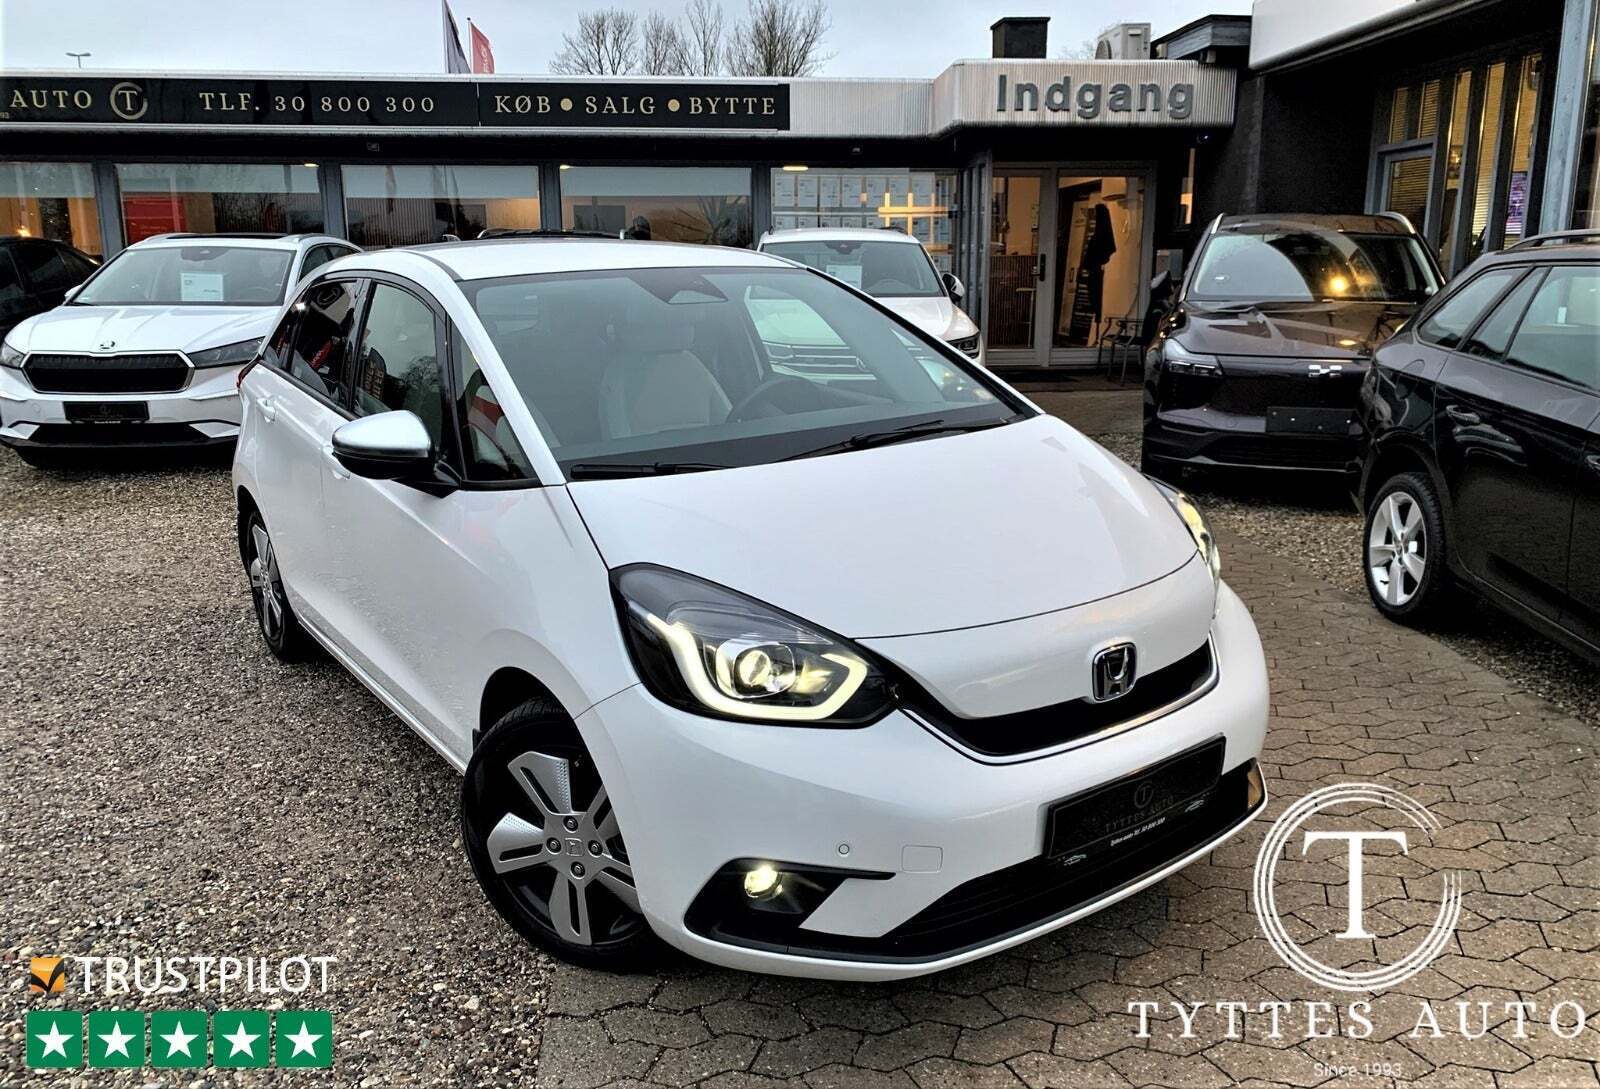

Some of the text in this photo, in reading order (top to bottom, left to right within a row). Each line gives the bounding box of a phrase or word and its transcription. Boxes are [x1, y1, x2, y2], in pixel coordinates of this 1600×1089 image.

[9, 89, 92, 109] AUTO
[200, 93, 434, 113] TLF. 30 800 300
[495, 95, 775, 115] KØB SALG BYTTE
[996, 74, 1194, 119] Indgang
